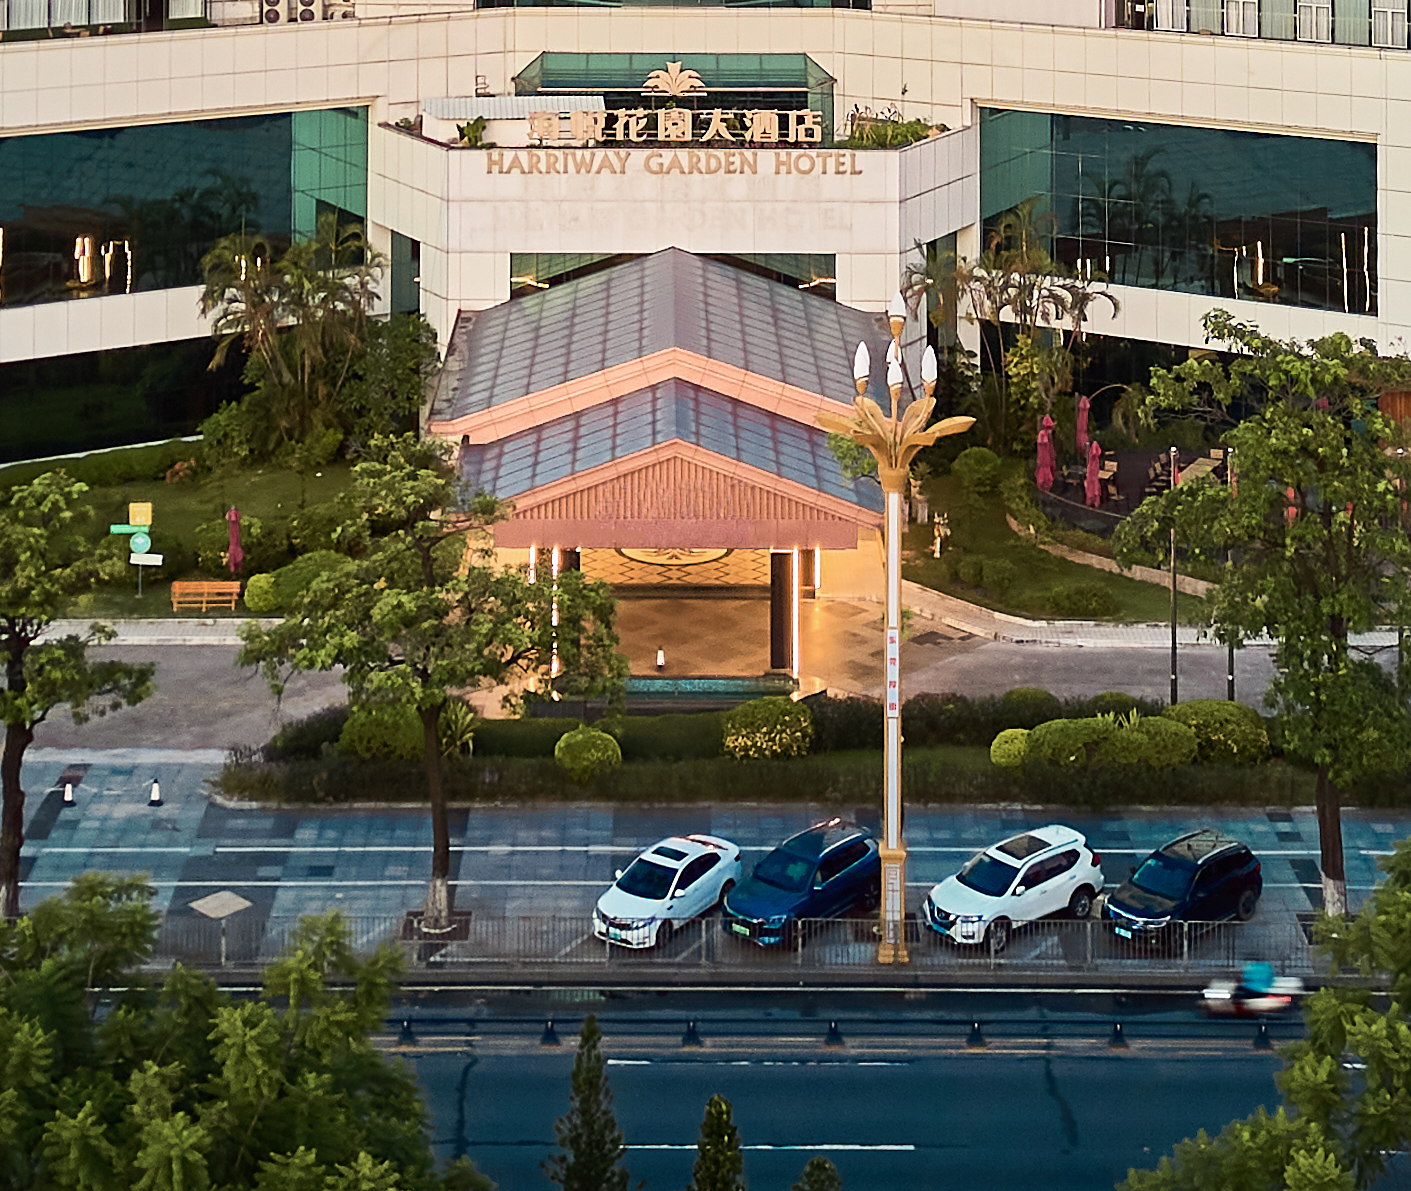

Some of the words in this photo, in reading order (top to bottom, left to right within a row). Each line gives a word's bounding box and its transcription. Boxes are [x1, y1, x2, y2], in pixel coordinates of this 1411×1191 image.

[487, 151, 631, 175] HARRIWAY
[643, 151, 758, 175] GARDEN
[774, 151, 863, 175] HOTEL
